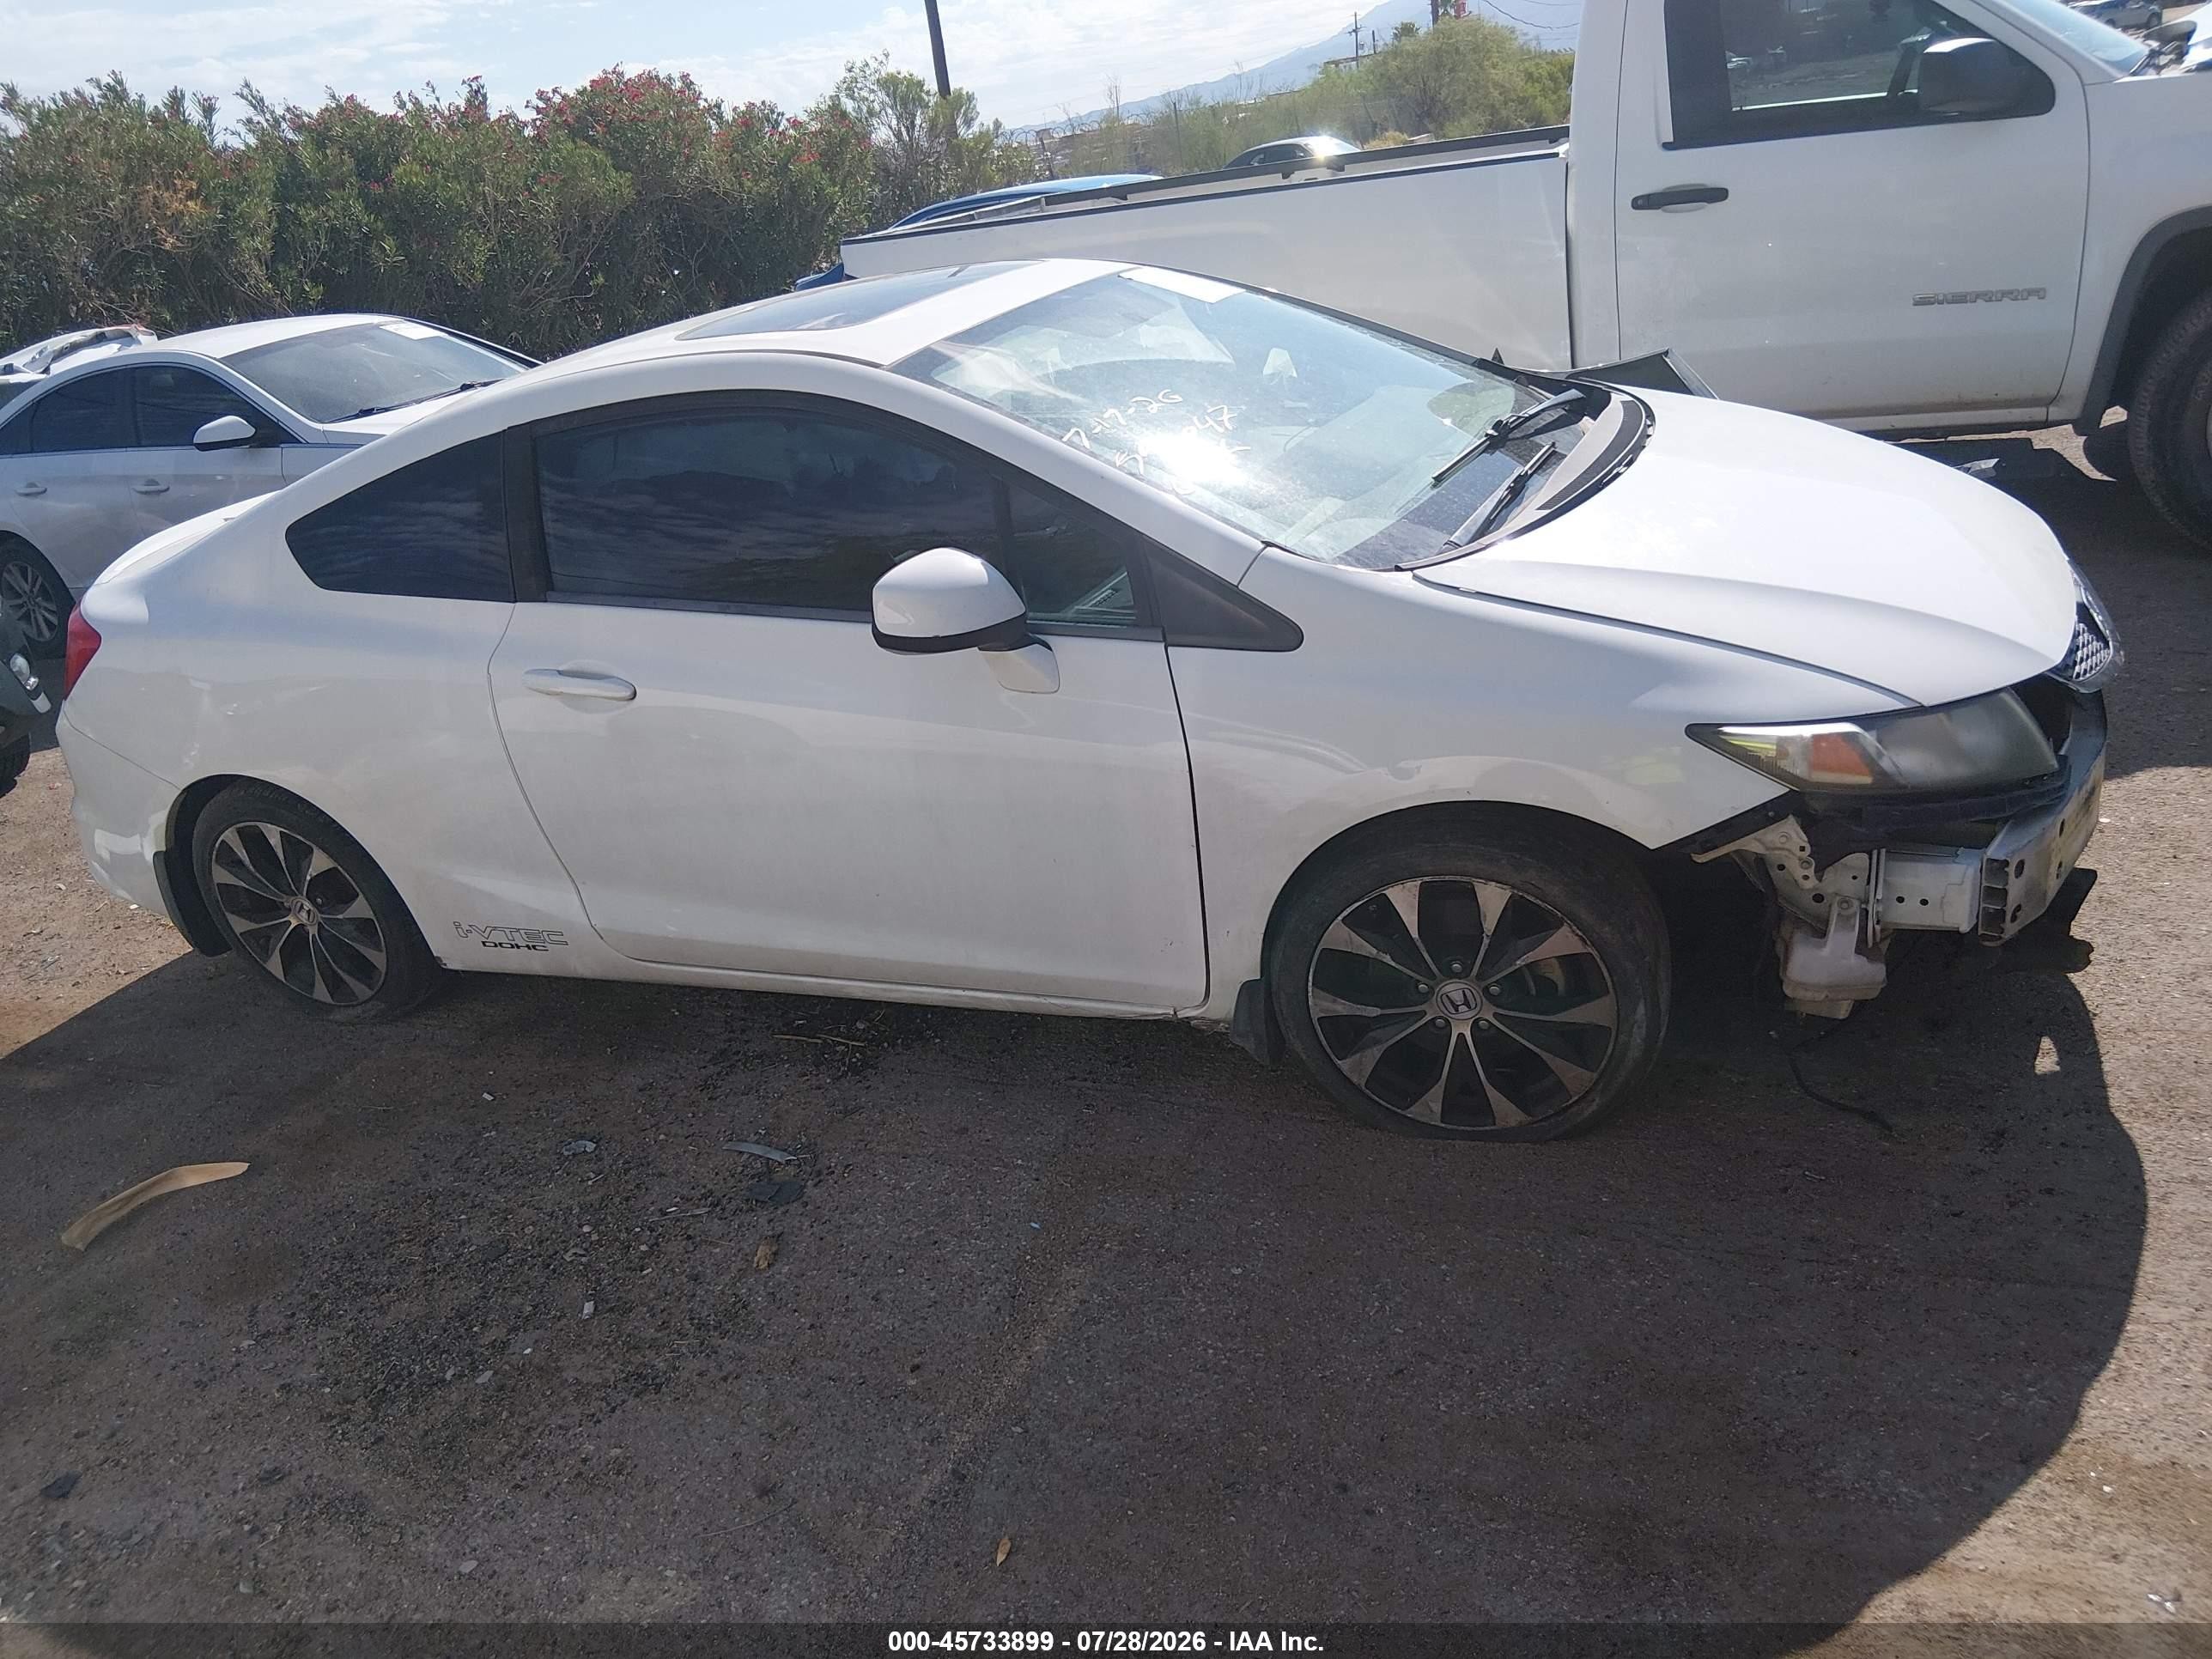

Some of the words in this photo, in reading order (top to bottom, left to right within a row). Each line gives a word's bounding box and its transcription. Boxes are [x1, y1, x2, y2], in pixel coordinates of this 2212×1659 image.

[1912, 287, 2047, 307] SIERRA
[453, 921, 568, 945] i-VTEC
[481, 940, 550, 951] DOHC
